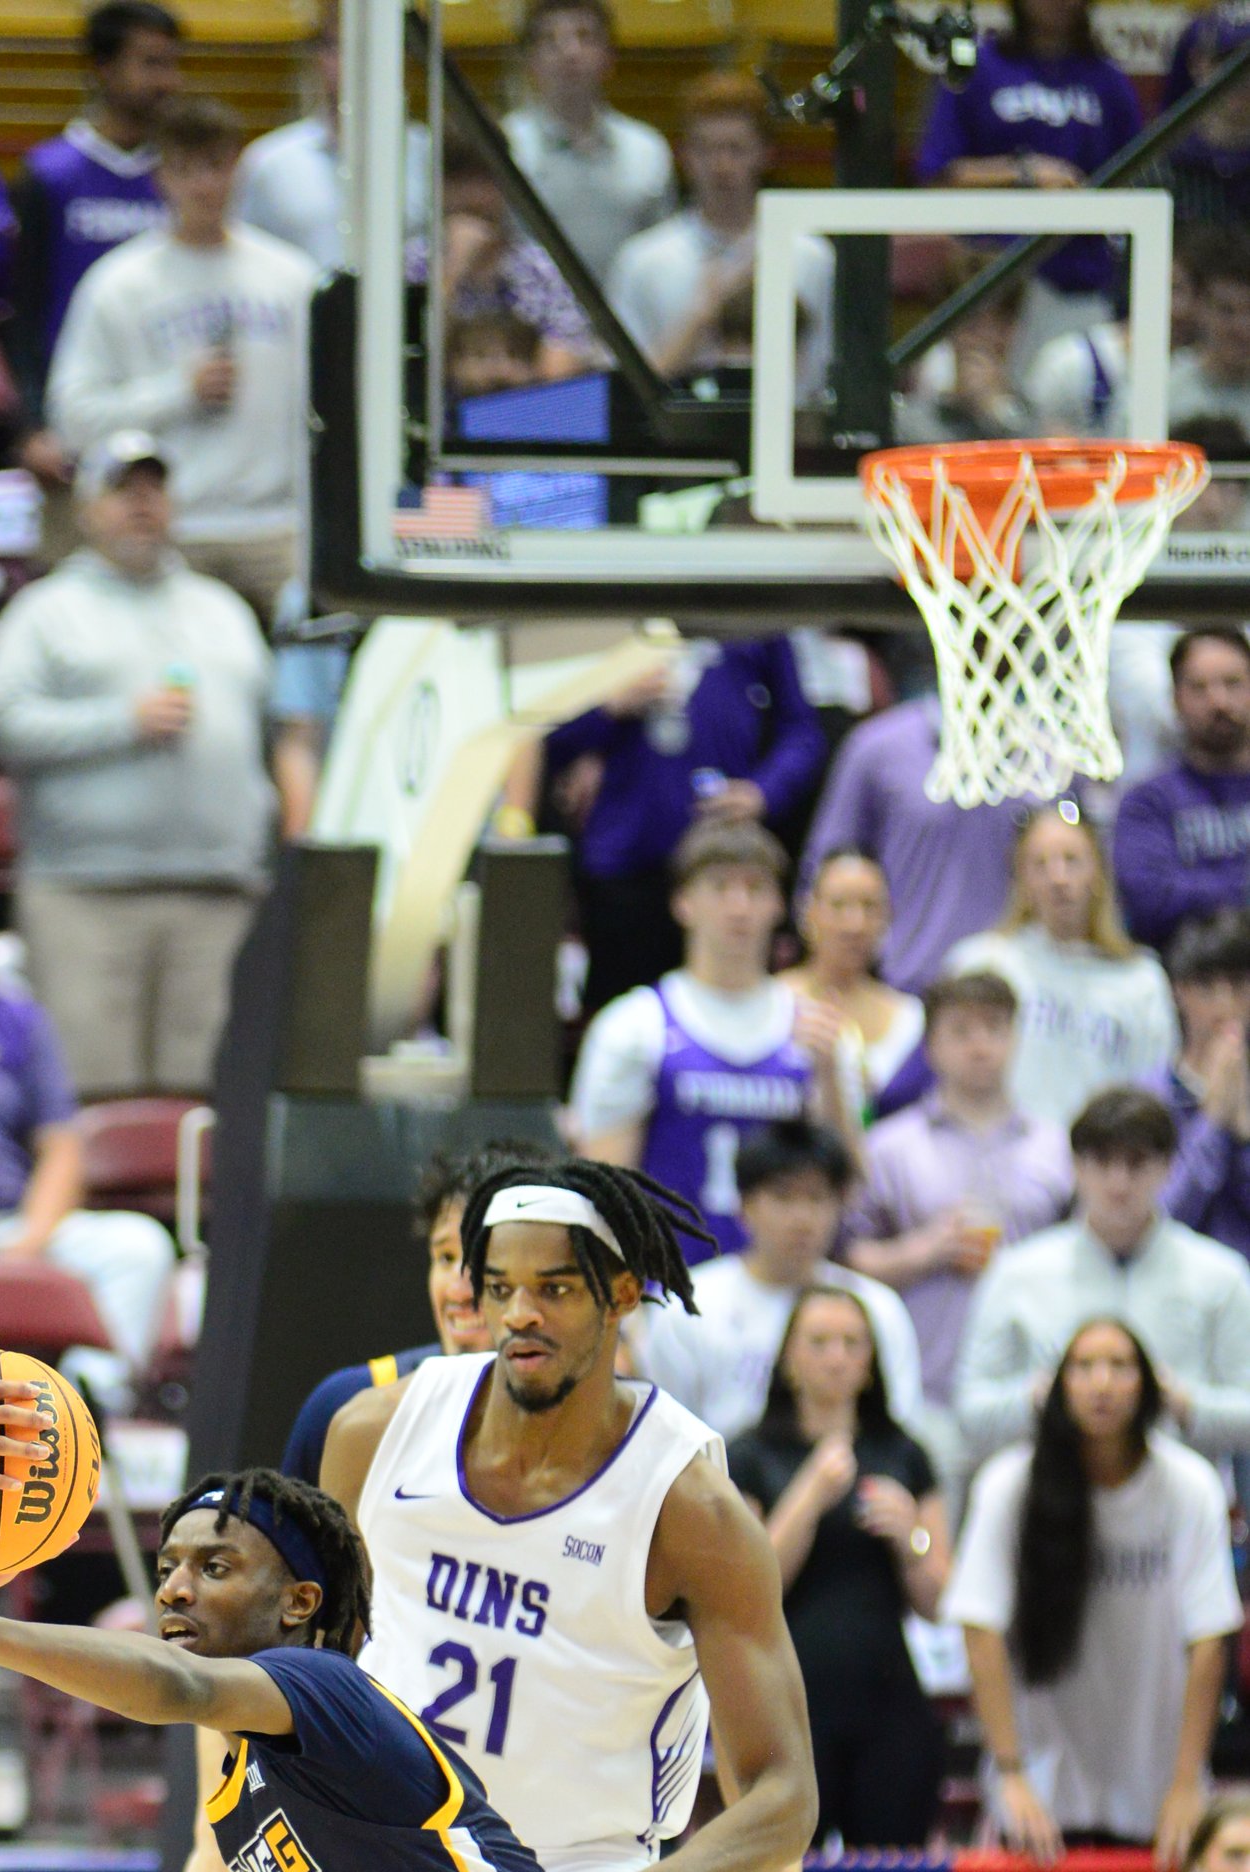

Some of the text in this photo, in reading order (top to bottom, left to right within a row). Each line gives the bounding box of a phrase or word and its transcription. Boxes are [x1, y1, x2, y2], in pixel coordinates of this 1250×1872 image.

[562, 1534, 606, 1567] SOCON
[426, 1551, 550, 1638] DINS
[420, 1640, 517, 1758] 21
